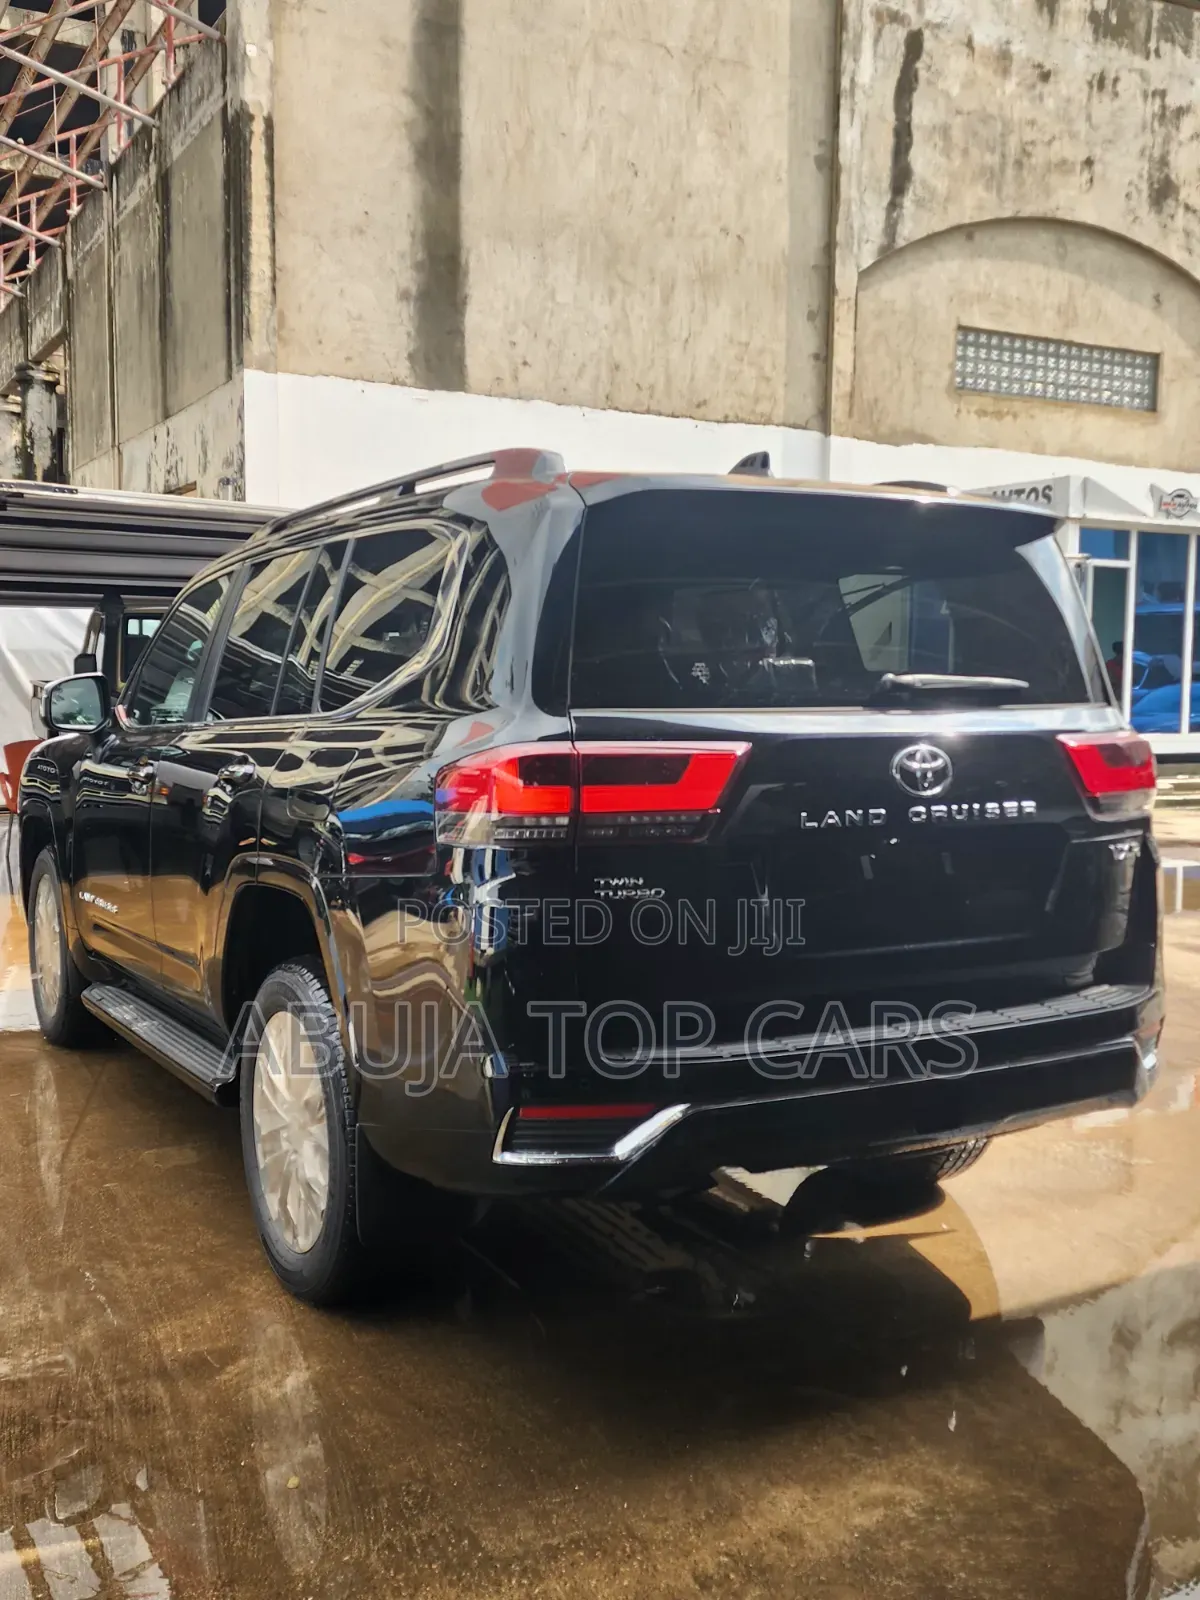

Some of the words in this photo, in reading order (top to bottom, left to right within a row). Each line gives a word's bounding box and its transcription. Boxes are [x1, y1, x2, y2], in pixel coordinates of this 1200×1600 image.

[800, 808, 886, 829] LAND
[908, 800, 1037, 824] CRUISER
[594, 877, 644, 887] TWIN
[594, 888, 666, 899] TURBO
